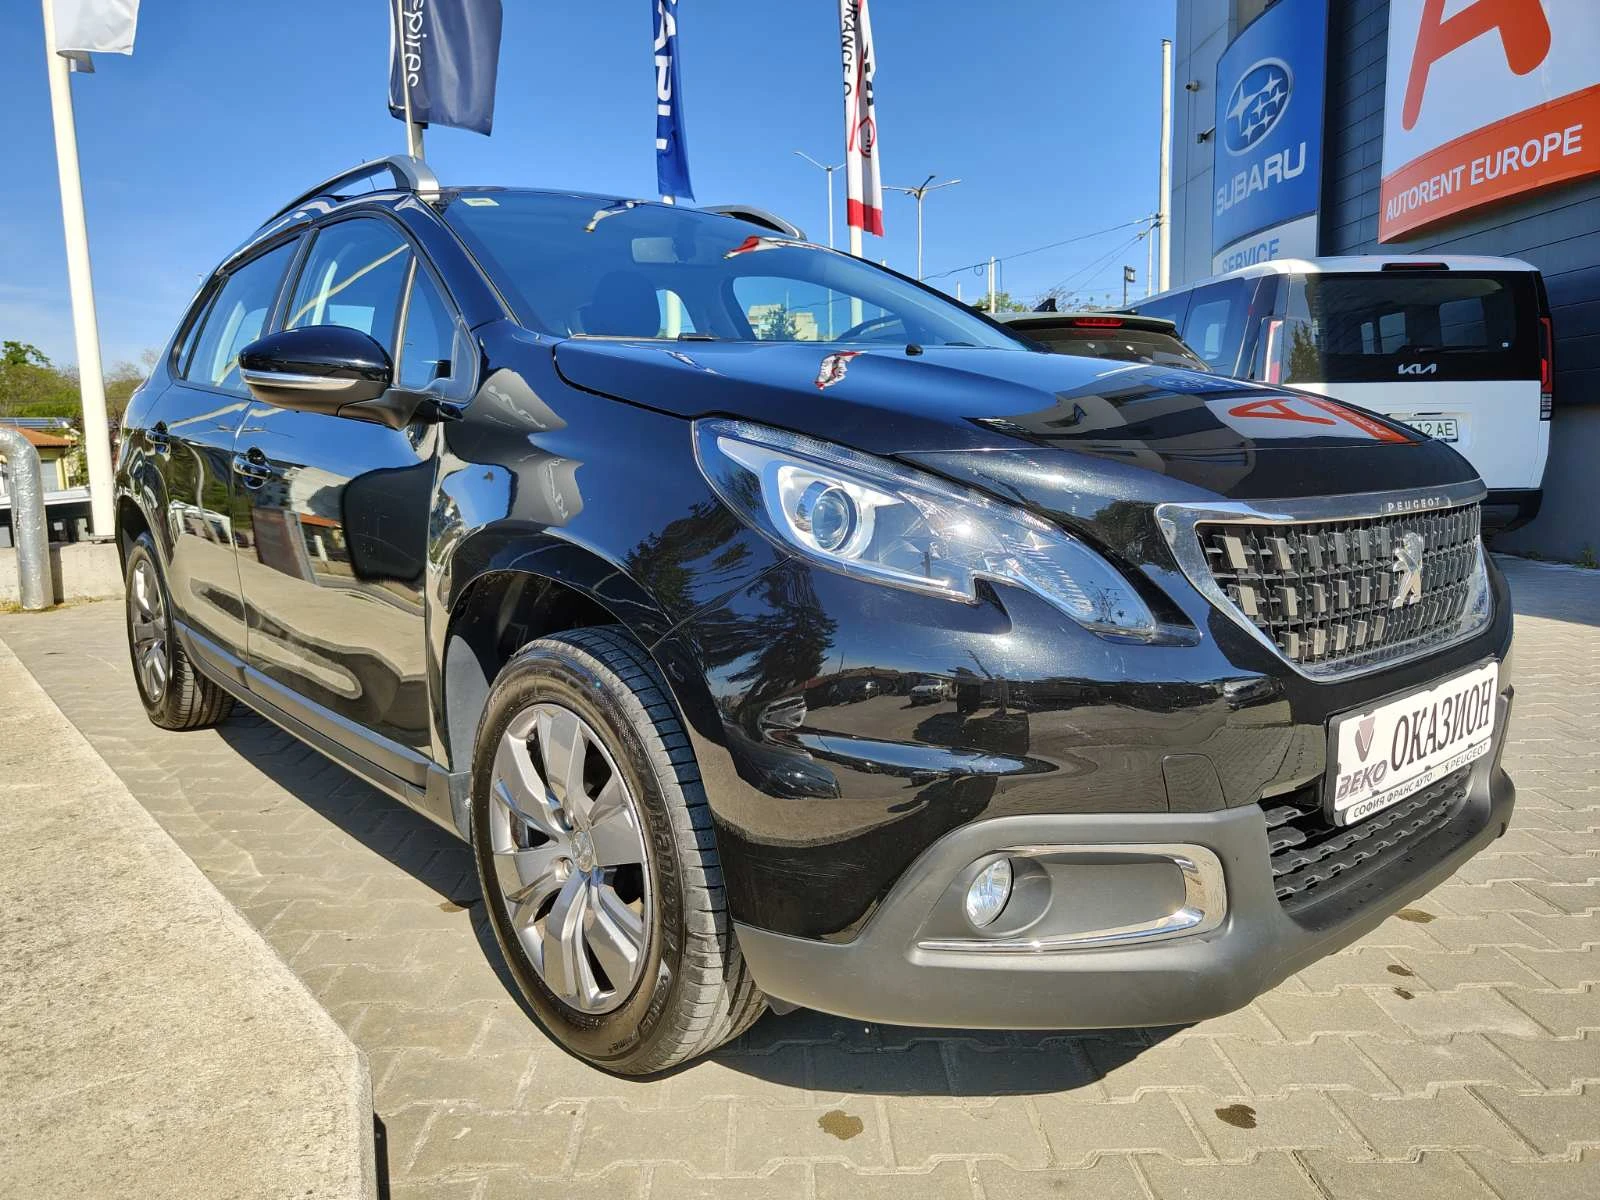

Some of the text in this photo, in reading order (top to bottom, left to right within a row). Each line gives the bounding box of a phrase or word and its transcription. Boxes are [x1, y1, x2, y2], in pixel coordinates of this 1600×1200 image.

[1216, 142, 1306, 217] SUBARU
[1386, 124, 1583, 222] AUTORENT EUROPE
[1397, 363, 1437, 375] KIA
[1410, 422, 1455, 437] 12 AE
[1388, 497, 1440, 512] PEUGEOT
[1391, 677, 1494, 772] ОКАЗИОН
[1449, 742, 1488, 770] PEUGEOT
[1353, 795, 1385, 818] СОФИЯ
[1387, 783, 1414, 802] ФРАНС
